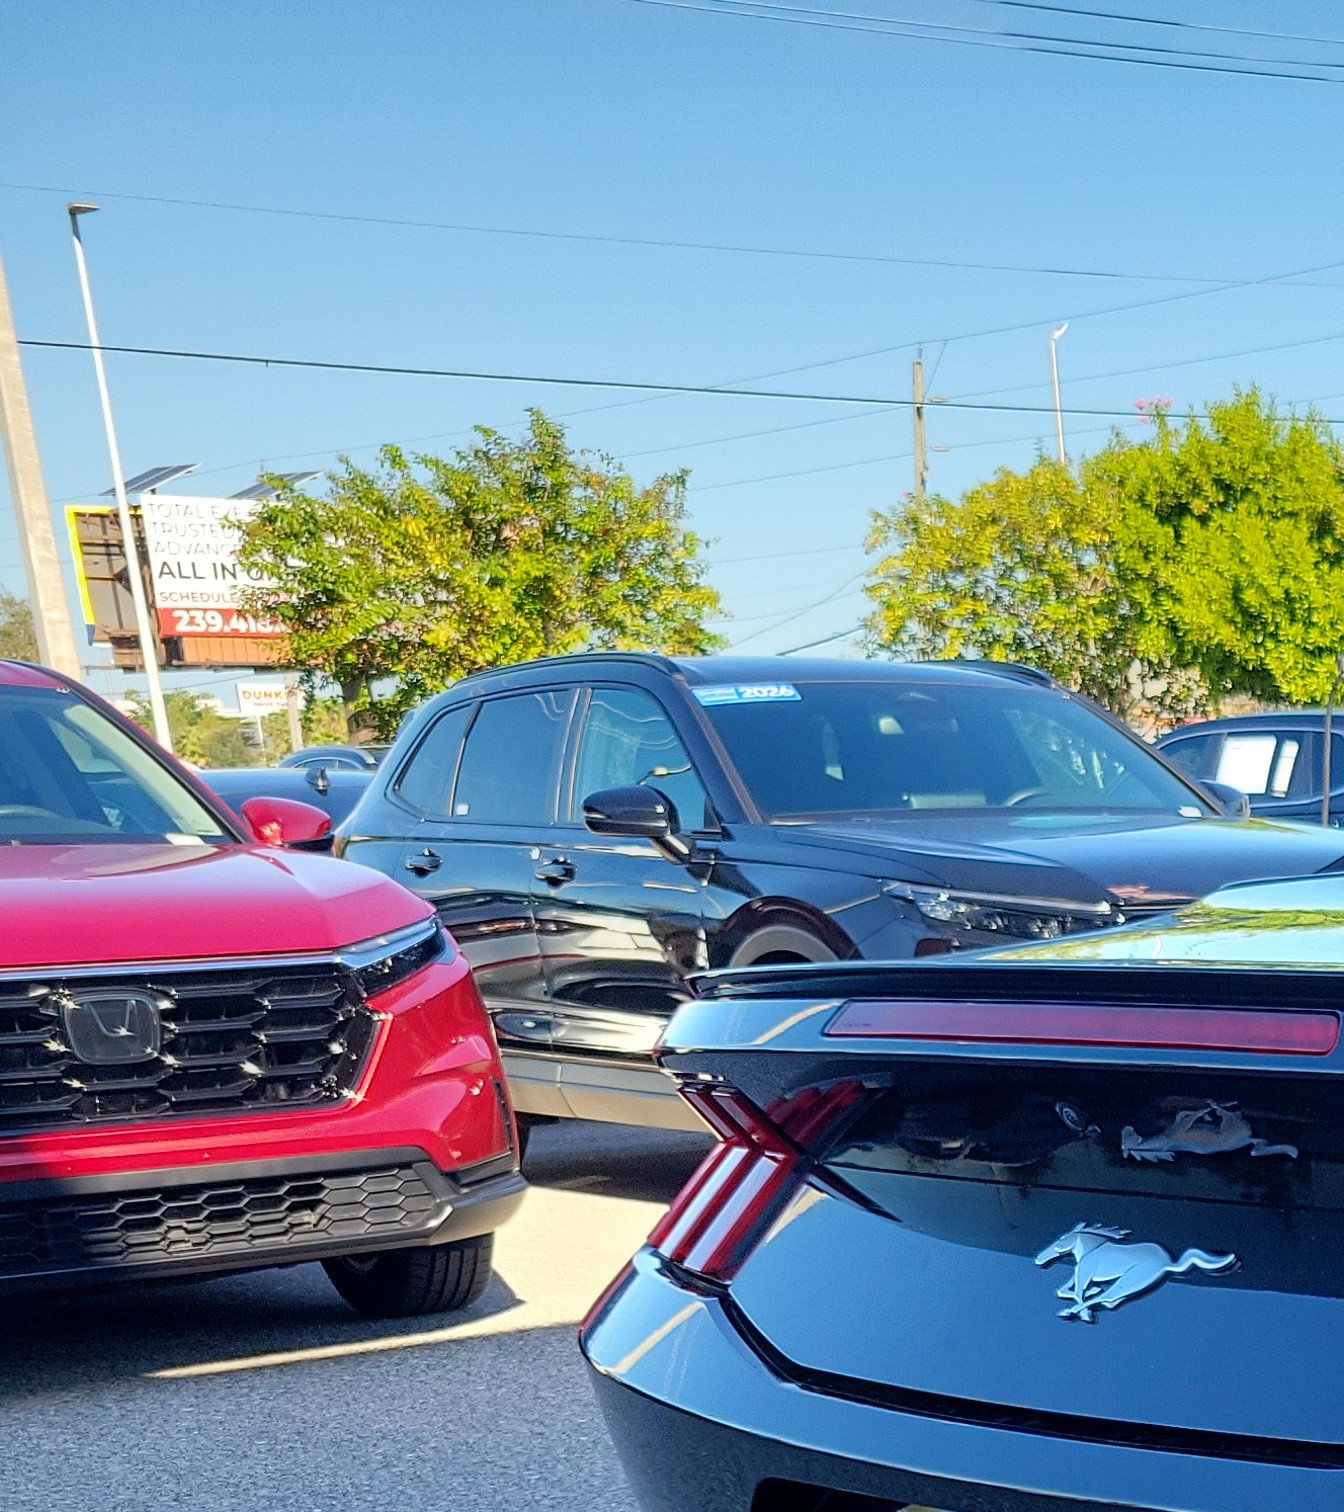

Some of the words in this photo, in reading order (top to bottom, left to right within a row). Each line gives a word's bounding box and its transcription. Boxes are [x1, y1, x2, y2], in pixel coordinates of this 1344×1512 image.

[148, 502, 206, 519] TOTAL
[158, 561, 206, 580] ALL
[212, 561, 238, 581] IN
[159, 590, 239, 604] SCHEDULE
